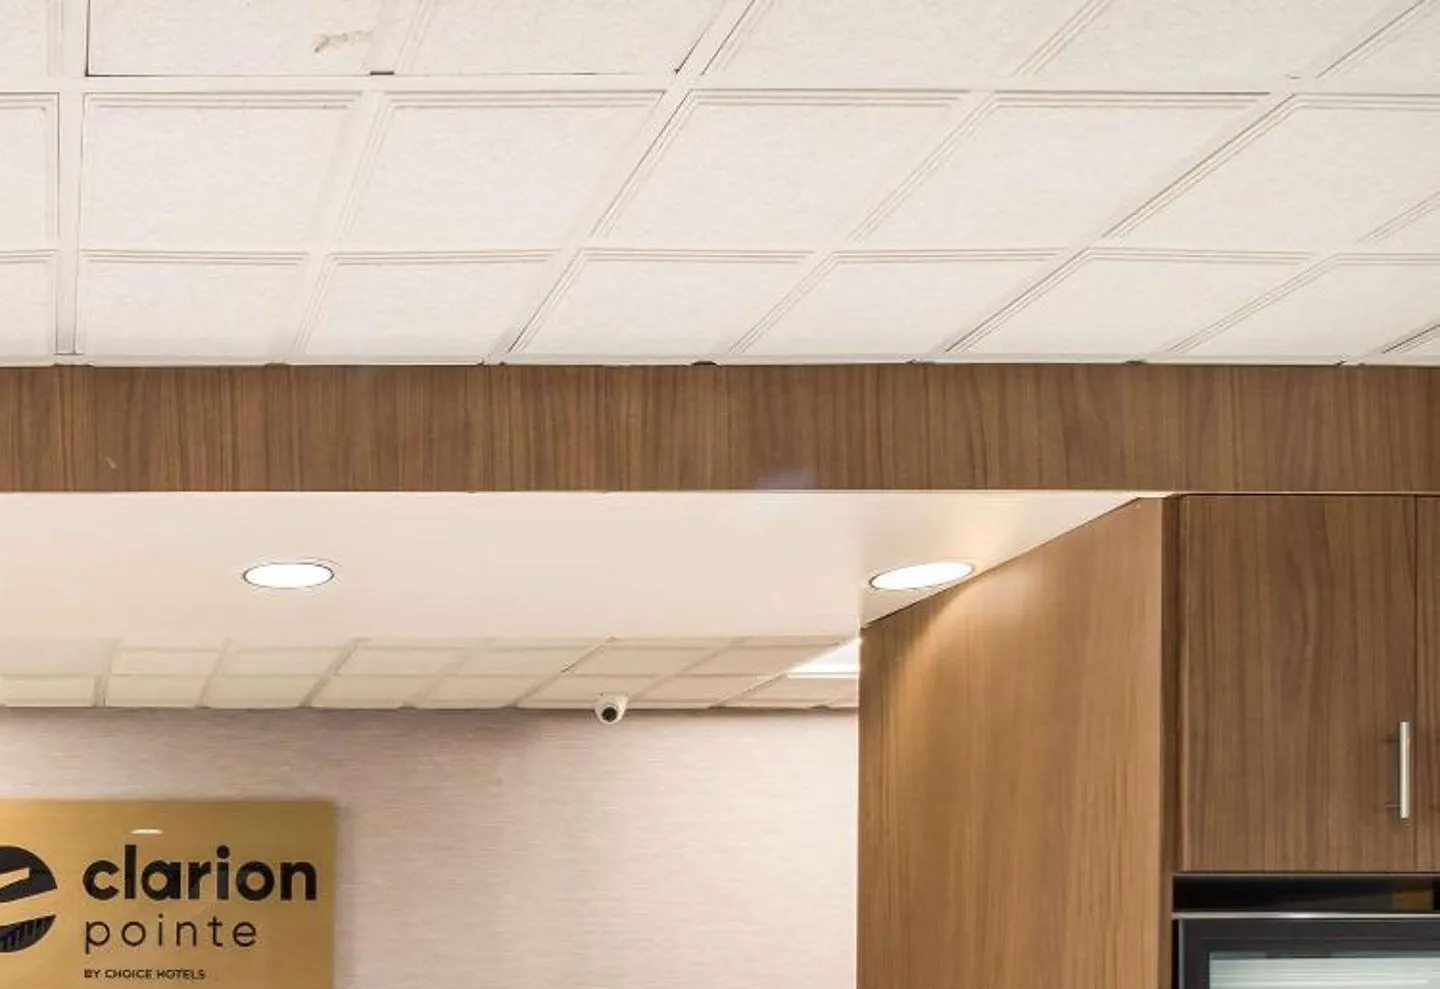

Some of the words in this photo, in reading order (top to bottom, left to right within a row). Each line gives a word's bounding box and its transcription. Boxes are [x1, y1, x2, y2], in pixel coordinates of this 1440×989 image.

[82, 844, 317, 900] clarion
[85, 913, 258, 954] pointe
[83, 968, 101, 979] BY
[105, 968, 153, 979] CHOICE
[156, 968, 206, 980] HOTELS
